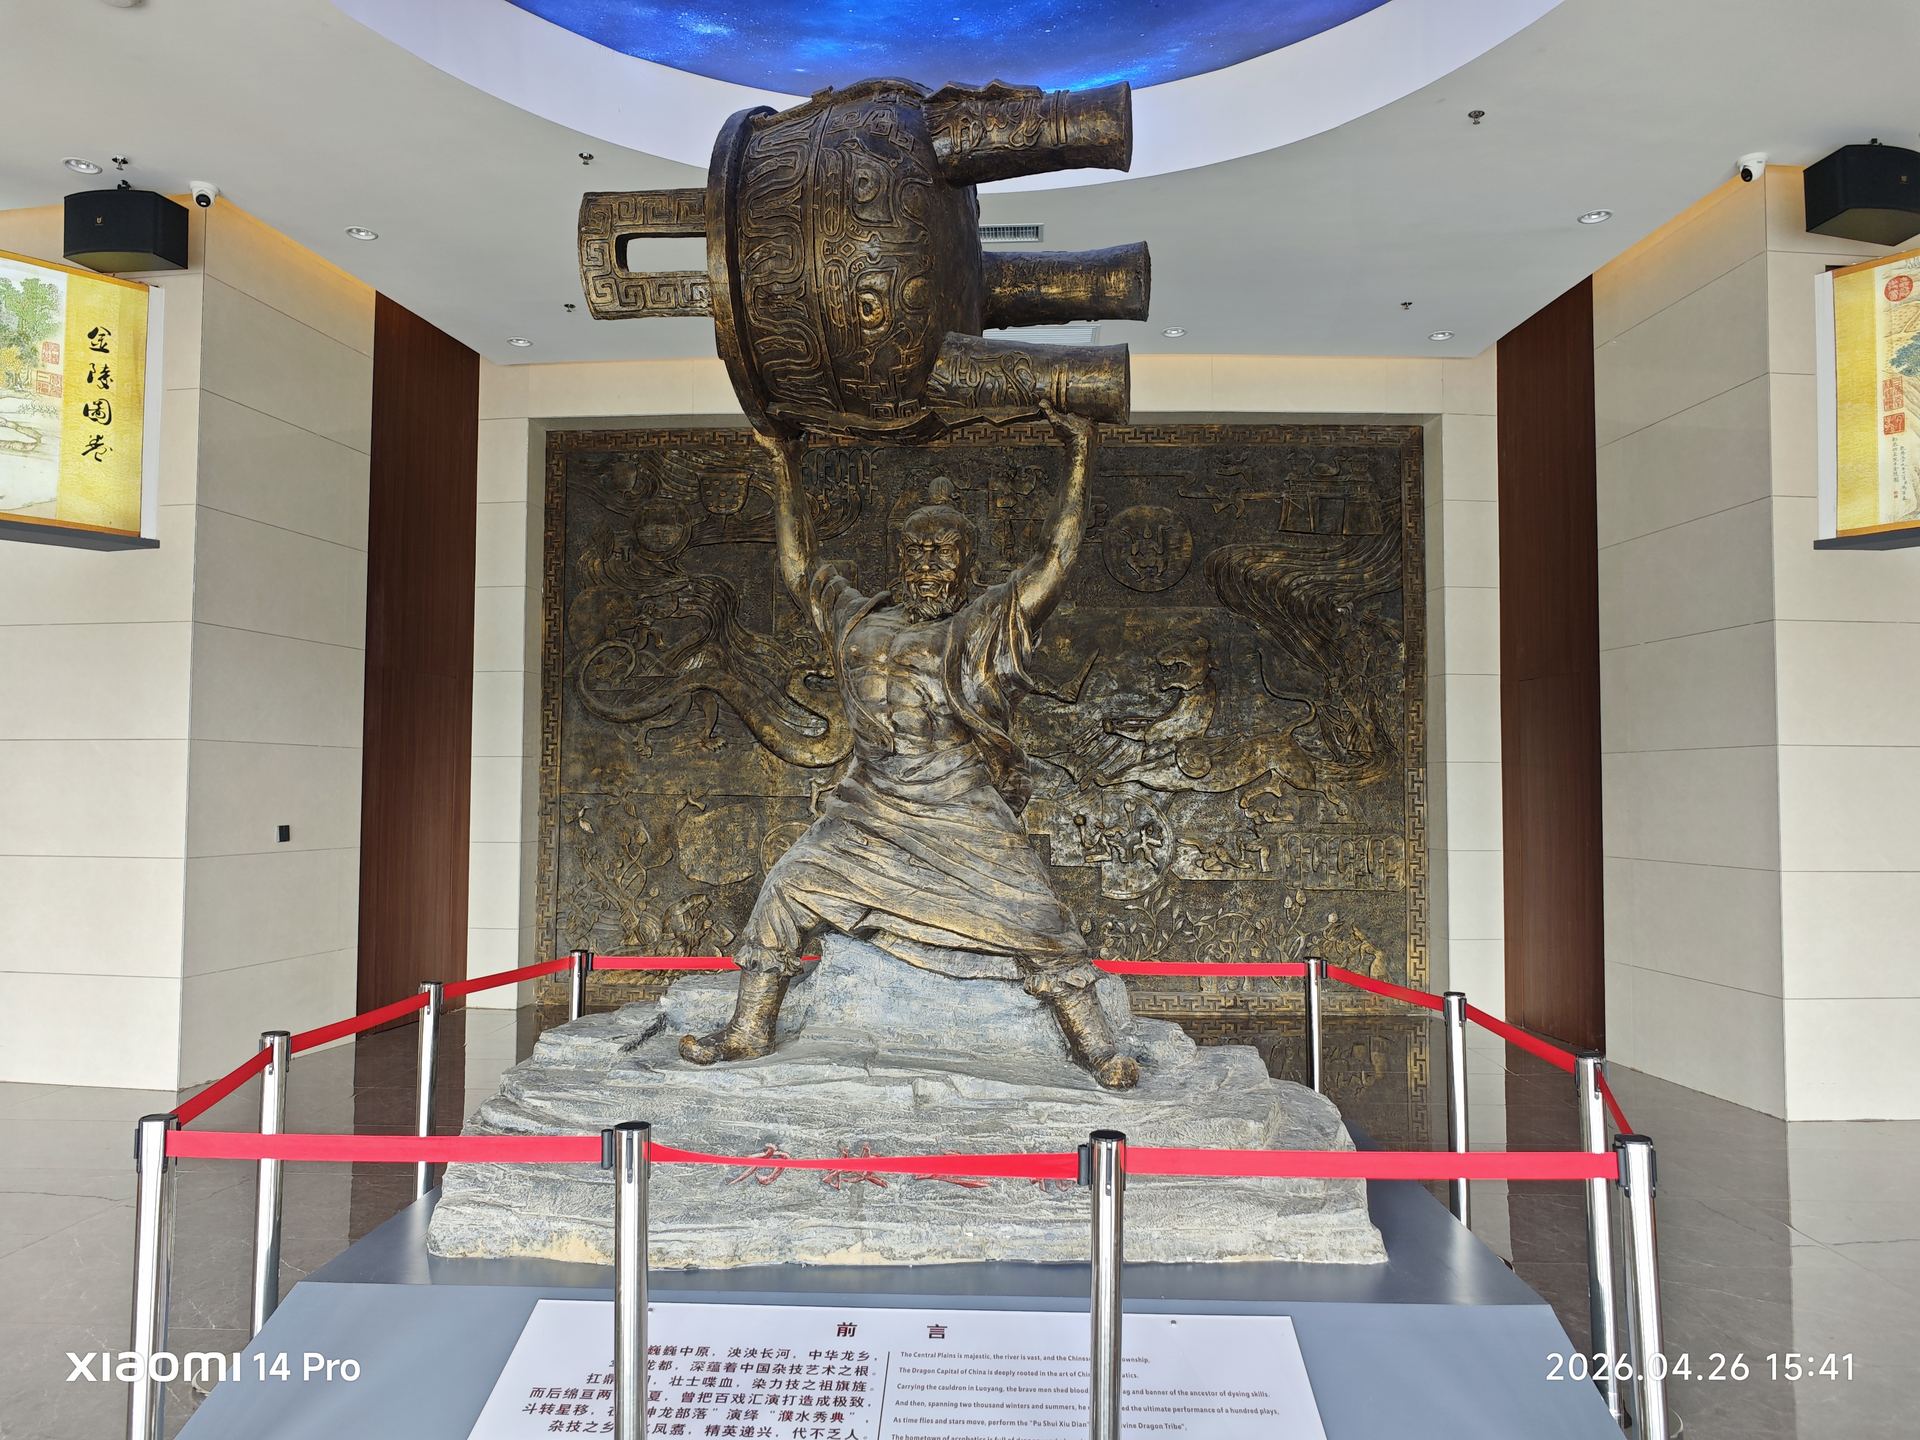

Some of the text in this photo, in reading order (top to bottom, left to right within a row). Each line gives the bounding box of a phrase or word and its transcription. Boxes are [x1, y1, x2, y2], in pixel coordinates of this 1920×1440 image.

[836, 1322, 948, 1339] 前 言
[1067, 1354, 1090, 1362] Chines
[609, 1359, 877, 1377] 龙都，深蕴着中国杂技艺术之根。
[899, 1366, 910, 1374] The
[911, 1367, 935, 1375] Dragon
[936, 1367, 959, 1375] Capital
[993, 1369, 1015, 1377] deeply
[586, 1373, 874, 1392] 扛鼎，壮士喋血，染力技之祖旗旌。
[529, 1387, 872, 1408] 而后绵亘两夏，曾把百戏汇演打造成极致，
[896, 1383, 924, 1391] Carrying
[1053, 1386, 1068, 1394] shed
[1070, 1386, 1088, 1394] blood
[1227, 1390, 1250, 1399] dyeing
[928, 1401, 958, 1409] spanning
[1031, 1402, 1043, 1410] and
[1078, 1403, 1086, 1411] he
[1130, 1404, 1141, 1412] the
[1143, 1405, 1170, 1413] ultimate
[1172, 1406, 1215, 1414] performance
[548, 1420, 869, 1440] 杂技之乡凤翥，精英递兴，代不乏人。
[892, 1416, 900, 1424] As
[902, 1416, 917, 1424] time
[919, 1416, 933, 1424] flies
[987, 1419, 1015, 1427] perform
[1017, 1419, 1027, 1427] the
[1042, 1419, 1057, 1427] Shui
[1058, 1420, 1069, 1428] Xiu
[1138, 1422, 1163, 1431] Dragon
